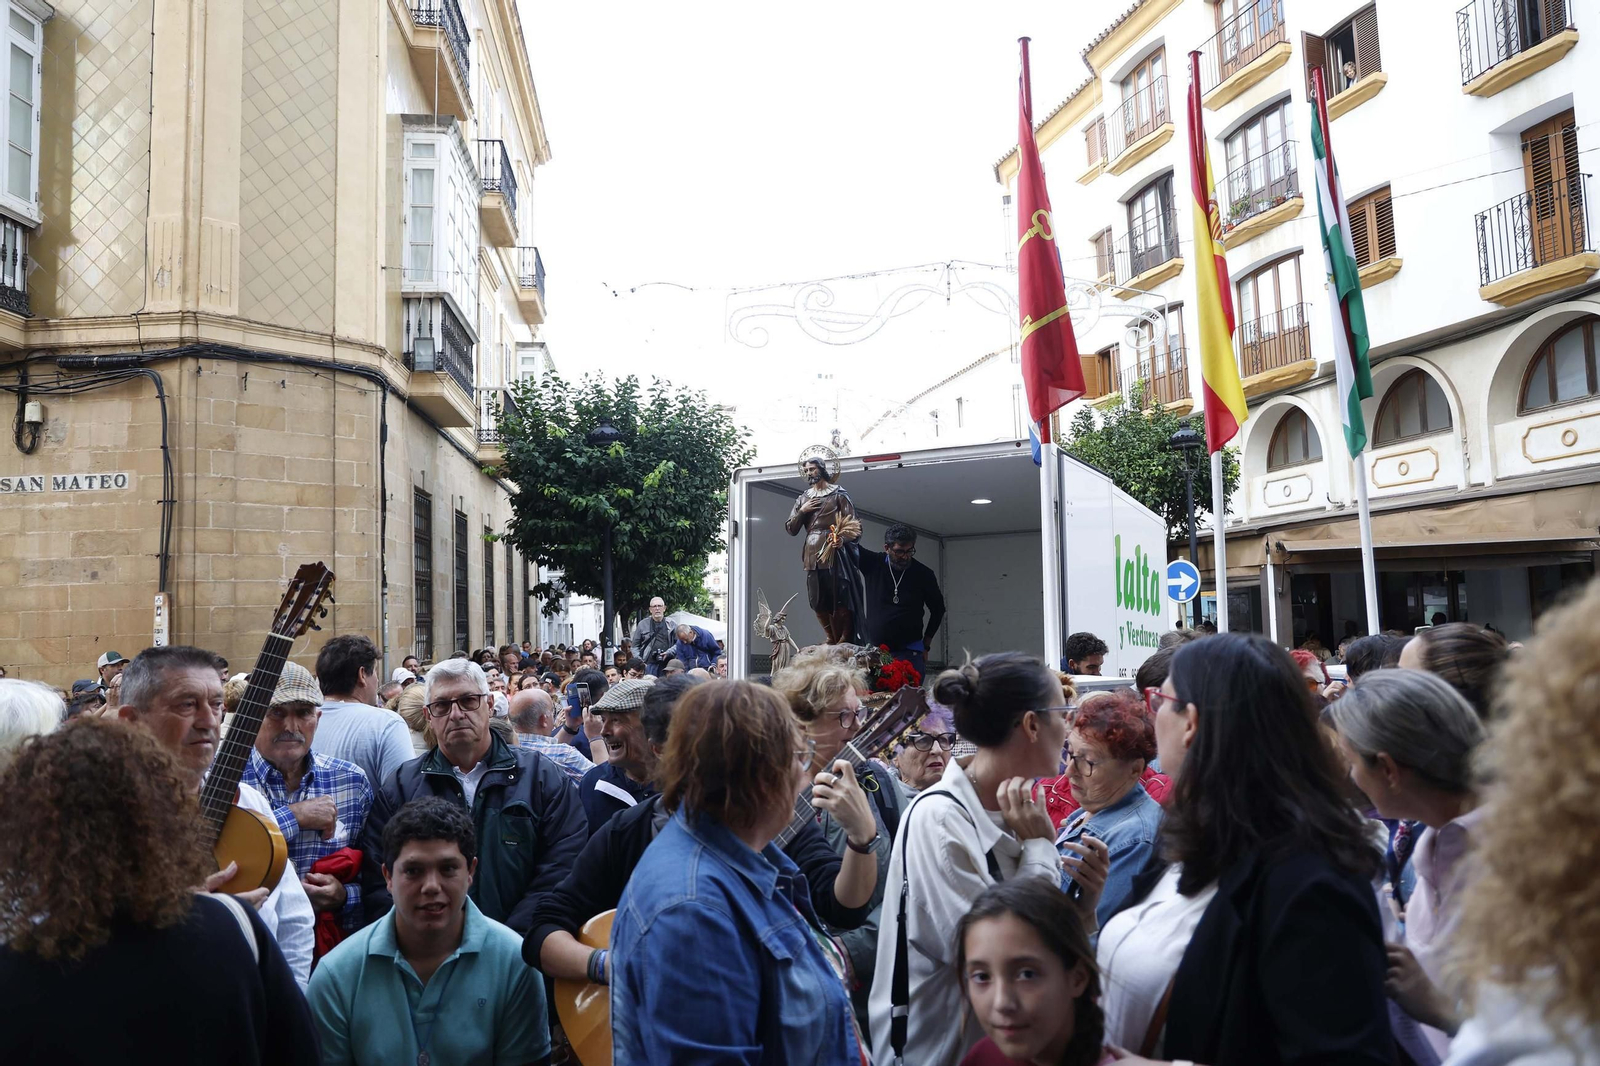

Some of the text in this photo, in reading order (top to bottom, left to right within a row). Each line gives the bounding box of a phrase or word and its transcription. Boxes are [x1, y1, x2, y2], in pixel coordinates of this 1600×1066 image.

[0, 474, 127, 492] SAN MATEO
[1119, 621, 1159, 650] y Verduras
